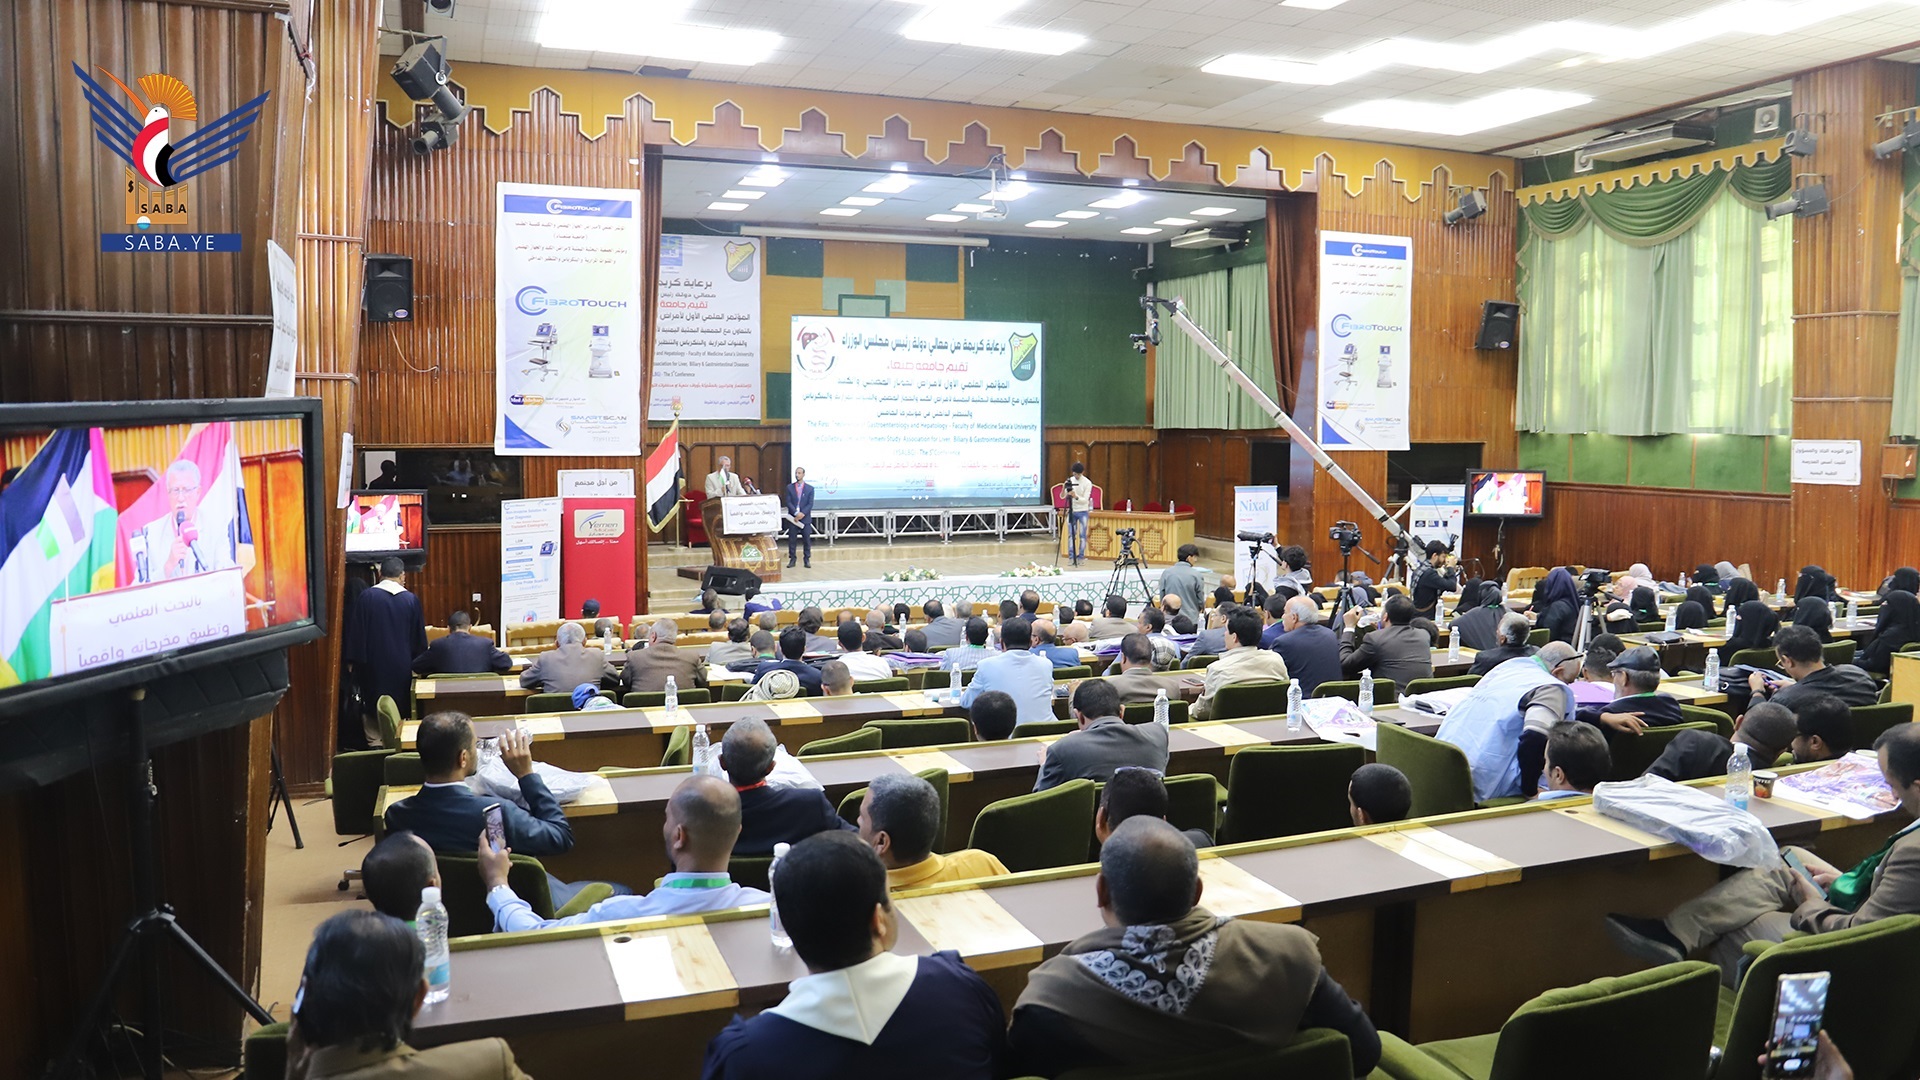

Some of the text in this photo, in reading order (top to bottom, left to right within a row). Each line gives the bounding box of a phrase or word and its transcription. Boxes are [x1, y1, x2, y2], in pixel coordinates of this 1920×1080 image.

[684, 279, 712, 289] برعاية
[660, 312, 684, 320] لأمراض
[686, 312, 700, 320] الأول
[726, 314, 750, 322] المؤتمر
[842, 332, 1005, 356] برعاية كريمة من معالي دولة رئيس مجلس الوزراء
[946, 362, 968, 373] تقيم
[944, 380, 958, 390] الأول
[961, 380, 983, 392] العلمي
[985, 380, 1010, 390] المؤتمر
[1021, 397, 1039, 405] بالتعاون
[597, 478, 607, 486] أجل
[1240, 499, 1269, 511] Nixaf
[109, 595, 201, 627] بالبحث العلمي
[186, 623, 230, 645] وتطبيق
[131, 636, 180, 655] مخرجاته
